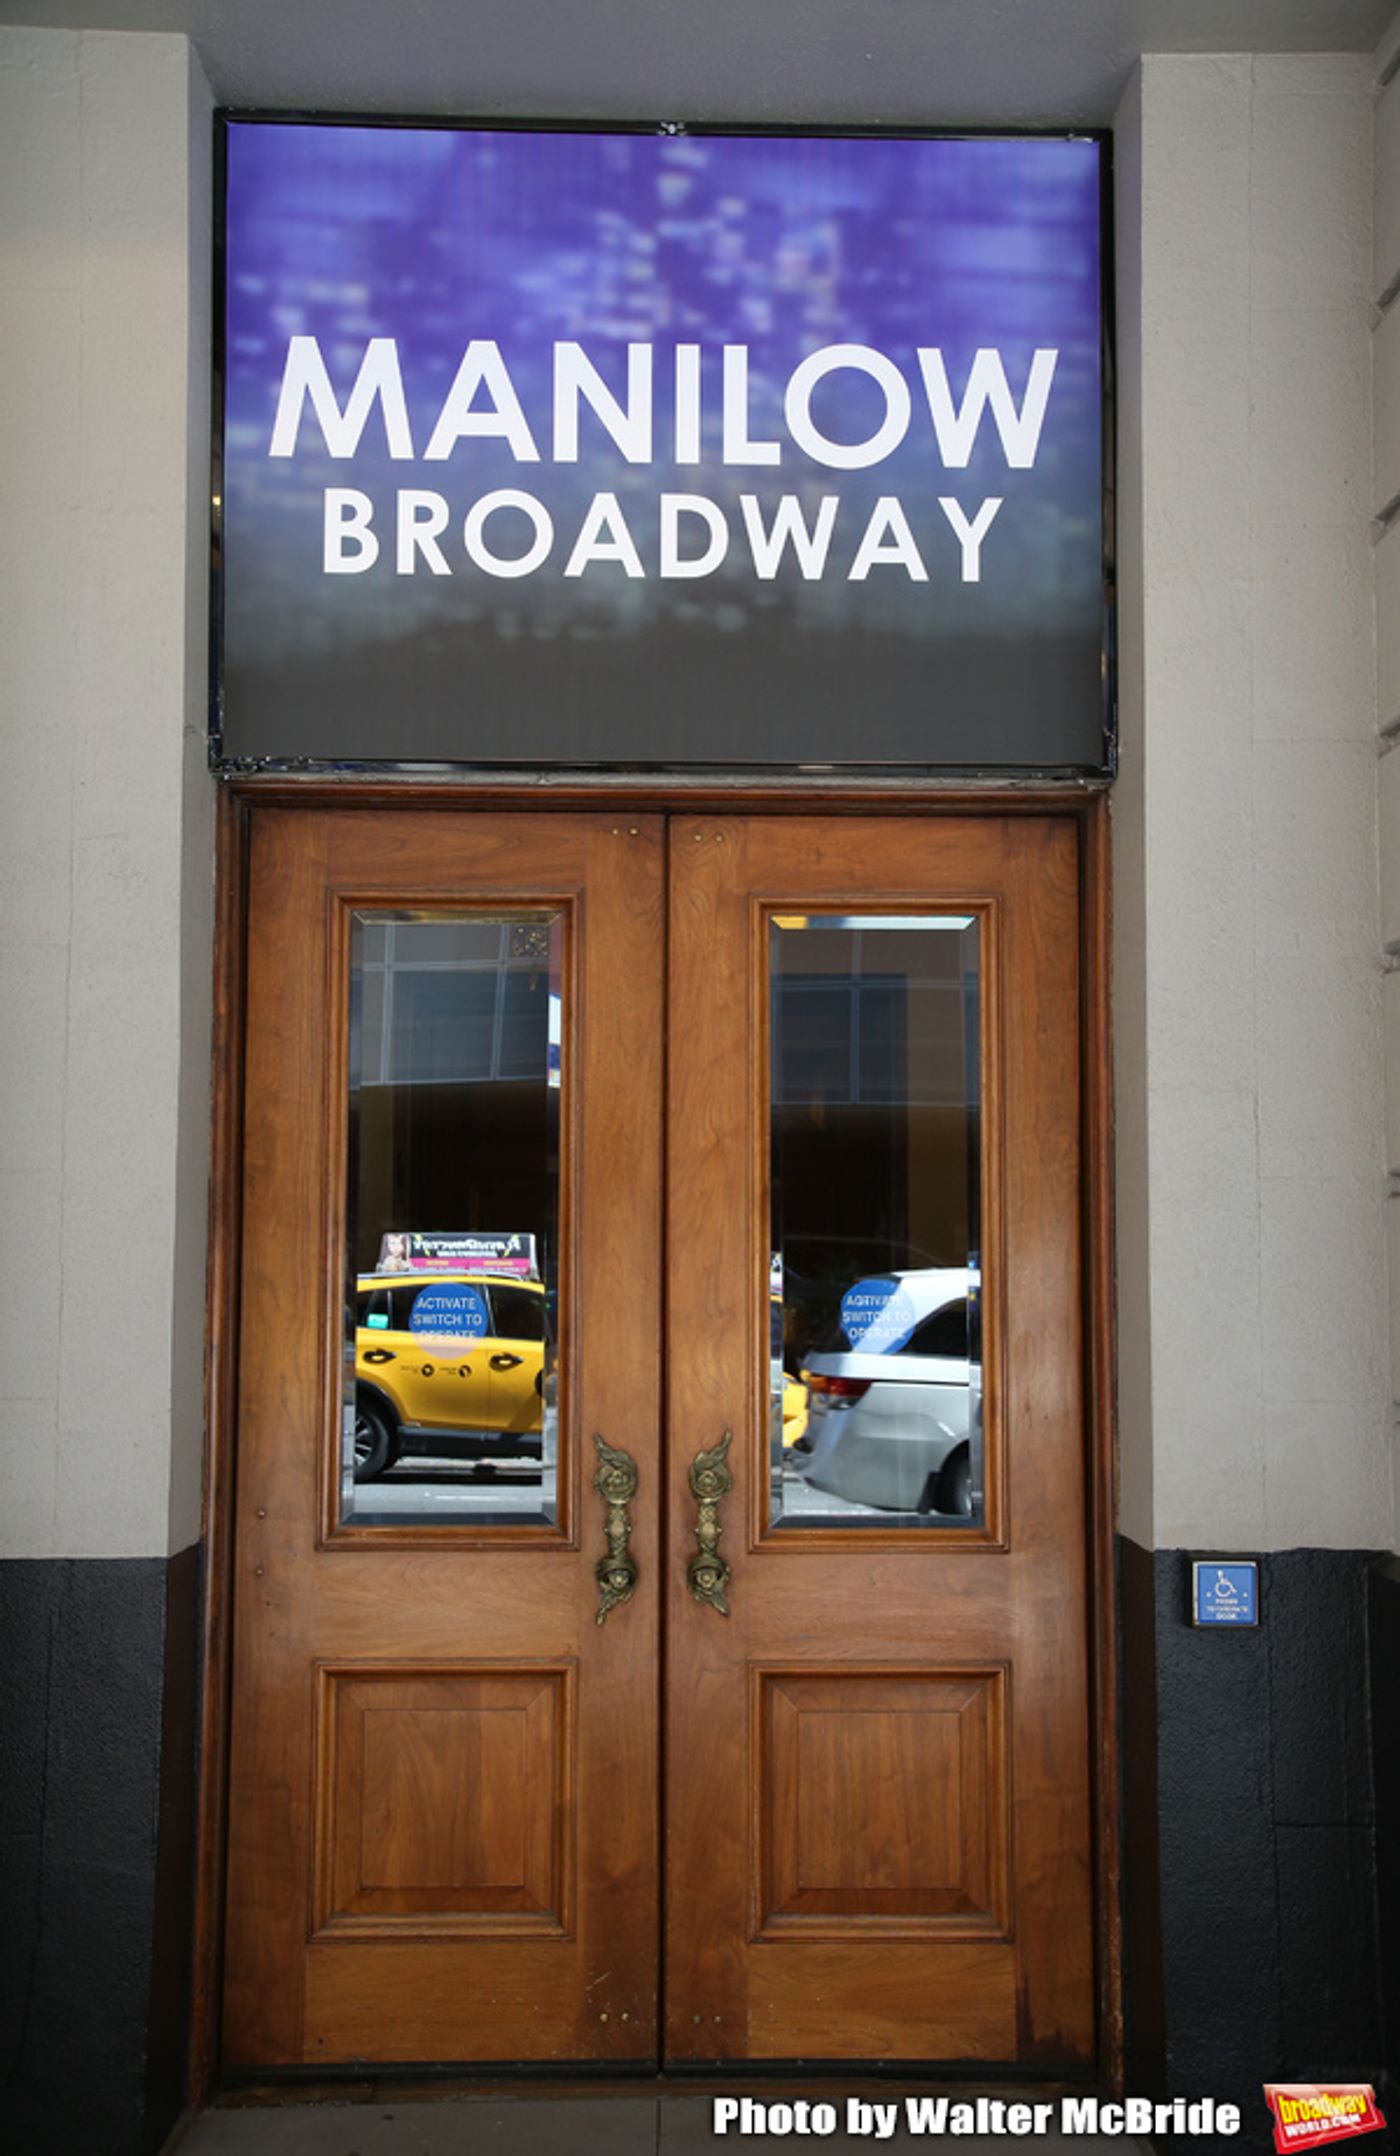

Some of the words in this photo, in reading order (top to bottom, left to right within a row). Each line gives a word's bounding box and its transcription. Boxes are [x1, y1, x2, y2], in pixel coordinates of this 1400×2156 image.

[269, 336, 1059, 469] MANILOW
[323, 488, 1003, 582] BROADWAY
[416, 1297, 476, 1310] ACTIVATE
[413, 1313, 462, 1326] SWITCH
[465, 1314, 482, 1326] TO
[842, 1312, 890, 1324] SWITCH
[893, 1312, 911, 1322] TO
